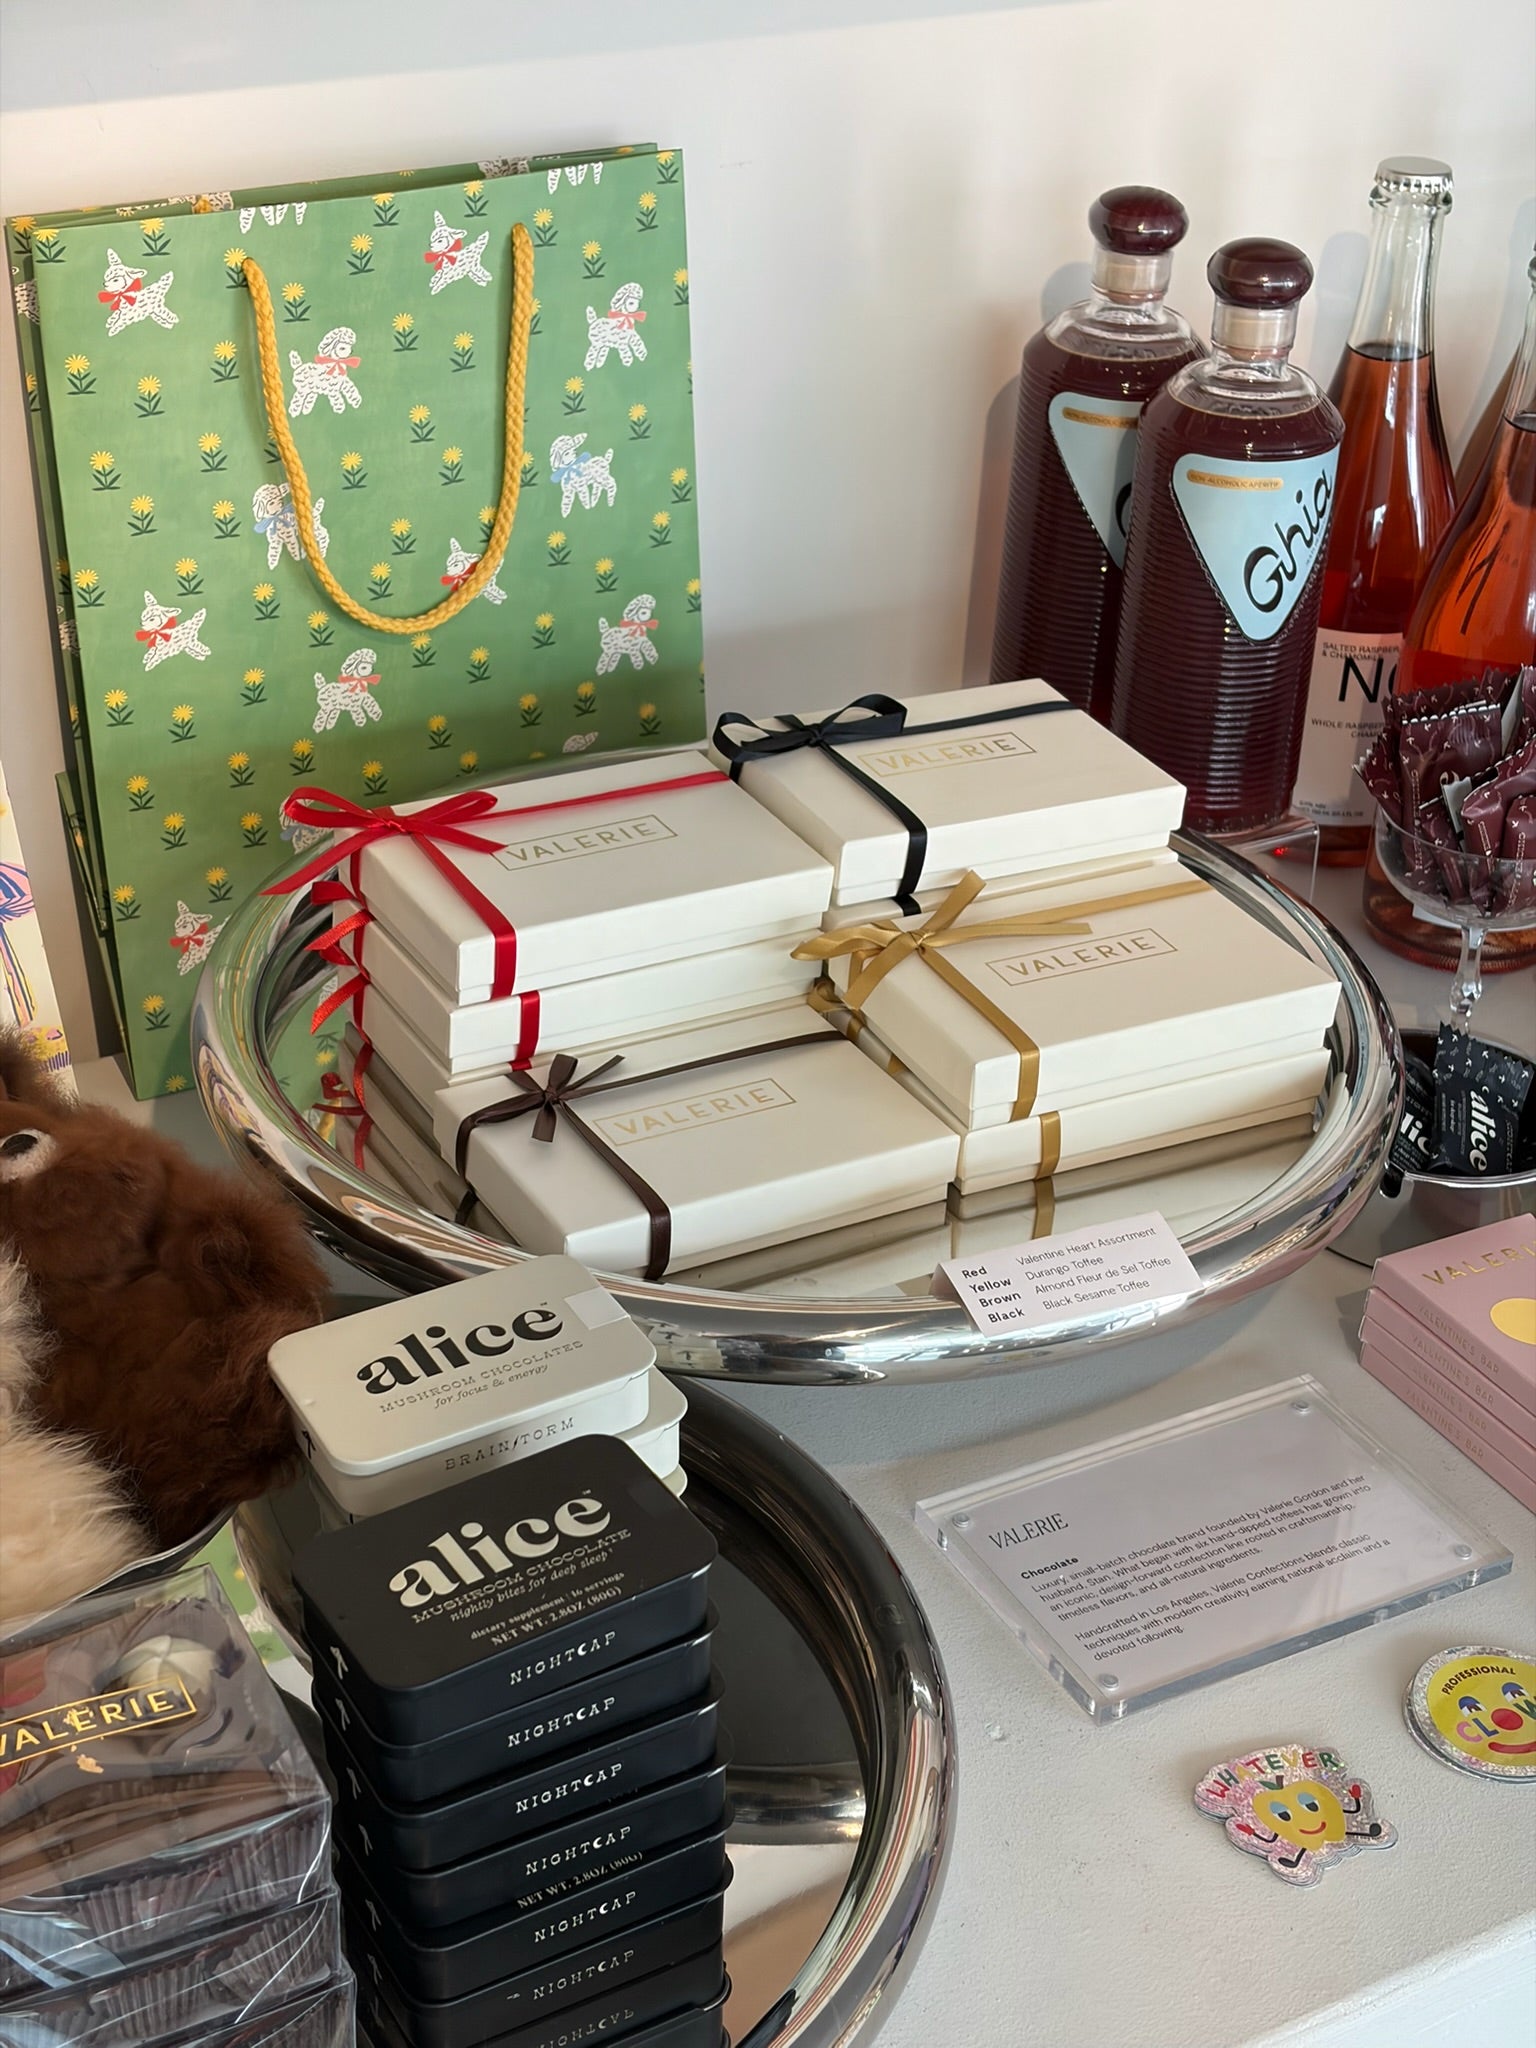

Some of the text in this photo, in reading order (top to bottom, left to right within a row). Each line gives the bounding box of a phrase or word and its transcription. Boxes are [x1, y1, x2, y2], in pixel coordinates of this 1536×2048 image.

[1244, 469, 1333, 613] Ghia
[1323, 642, 1400, 654] SALTED RASPBER
[1311, 718, 1386, 731] WHOLE RASPBER
[1351, 730, 1383, 739] CHAM
[876, 739, 1016, 770] VALERIE
[506, 822, 657, 861] VALERIE
[1006, 936, 1156, 976] VALERIE
[613, 1087, 775, 1135] VALERIE
[1469, 1090, 1497, 1171] alice
[962, 1227, 1157, 1279] Red Valentine Heart Assortment
[969, 1255, 1104, 1294] Yellow Durango Toffee
[1422, 1243, 1536, 1284] VALERI
[979, 1257, 1172, 1308] Brown Almond Fleur de Sel Toffee
[988, 1279, 1151, 1323] Black Black Sesame Toffee
[357, 1309, 564, 1395] alice
[1480, 1355, 1500, 1376] BAR
[380, 1375, 476, 1413] MUSHROOM
[433, 1364, 549, 1409] for focus & energy
[1475, 1385, 1496, 1406] BAR
[1468, 1411, 1488, 1432] BAR
[1465, 1439, 1485, 1461] BAR
[388, 1497, 611, 1608] alice
[989, 1513, 1069, 1550] VALERIE
[1031, 1474, 1365, 1593] Luxury, small-batch chocolate brand founded by Valerie Gordon and her
[1040, 1484, 1372, 1603] husband, Stan. What began with six hand-dipped toffees has grown into
[411, 1528, 632, 1624] MUSHROOM CHOCOLATE
[1021, 1556, 1079, 1580] Chocolate
[1050, 1503, 1356, 1612] an iconic, design-forward confection line rooted in craftsmanship.
[450, 1595, 495, 1622] nightly
[497, 1585, 527, 1604] bites
[528, 1575, 547, 1593] for
[551, 1564, 578, 1583] deep
[508, 1597, 565, 1626] supplement
[584, 1572, 625, 1594] servings
[1058, 1546, 1263, 1622] timeless flavors, and all-natural ingredients.
[1075, 1532, 1371, 1641] Handcrafted in Los Angeles, Valerie Confections blends classic
[1084, 1625, 1140, 1651] techniques
[1141, 1619, 1164, 1632] with
[1163, 1606, 1203, 1624] modern
[1203, 1587, 1250, 1609] creativity
[1250, 1574, 1288, 1592] earning
[1287, 1561, 1325, 1580] national
[1326, 1550, 1363, 1567] acclaim
[1363, 1541, 1382, 1554] and
[491, 1628, 519, 1647] NET
[521, 1615, 549, 1633] WT.
[1094, 1625, 1185, 1661] devoted following.
[509, 1631, 617, 1686] NIGHTCAP
[1441, 1665, 1517, 1696] PROFESSIONAL
[508, 1697, 615, 1748] NIGHTCAP
[515, 1763, 622, 1814] NIGHTCAP
[1206, 1752, 1340, 1799] WHATEVER
[525, 1826, 631, 1876] NIGHTCAP
[517, 1891, 543, 1910] NET
[534, 1891, 636, 1943] NIGHTCAP
[533, 1949, 635, 2000] NIGHTCAP
